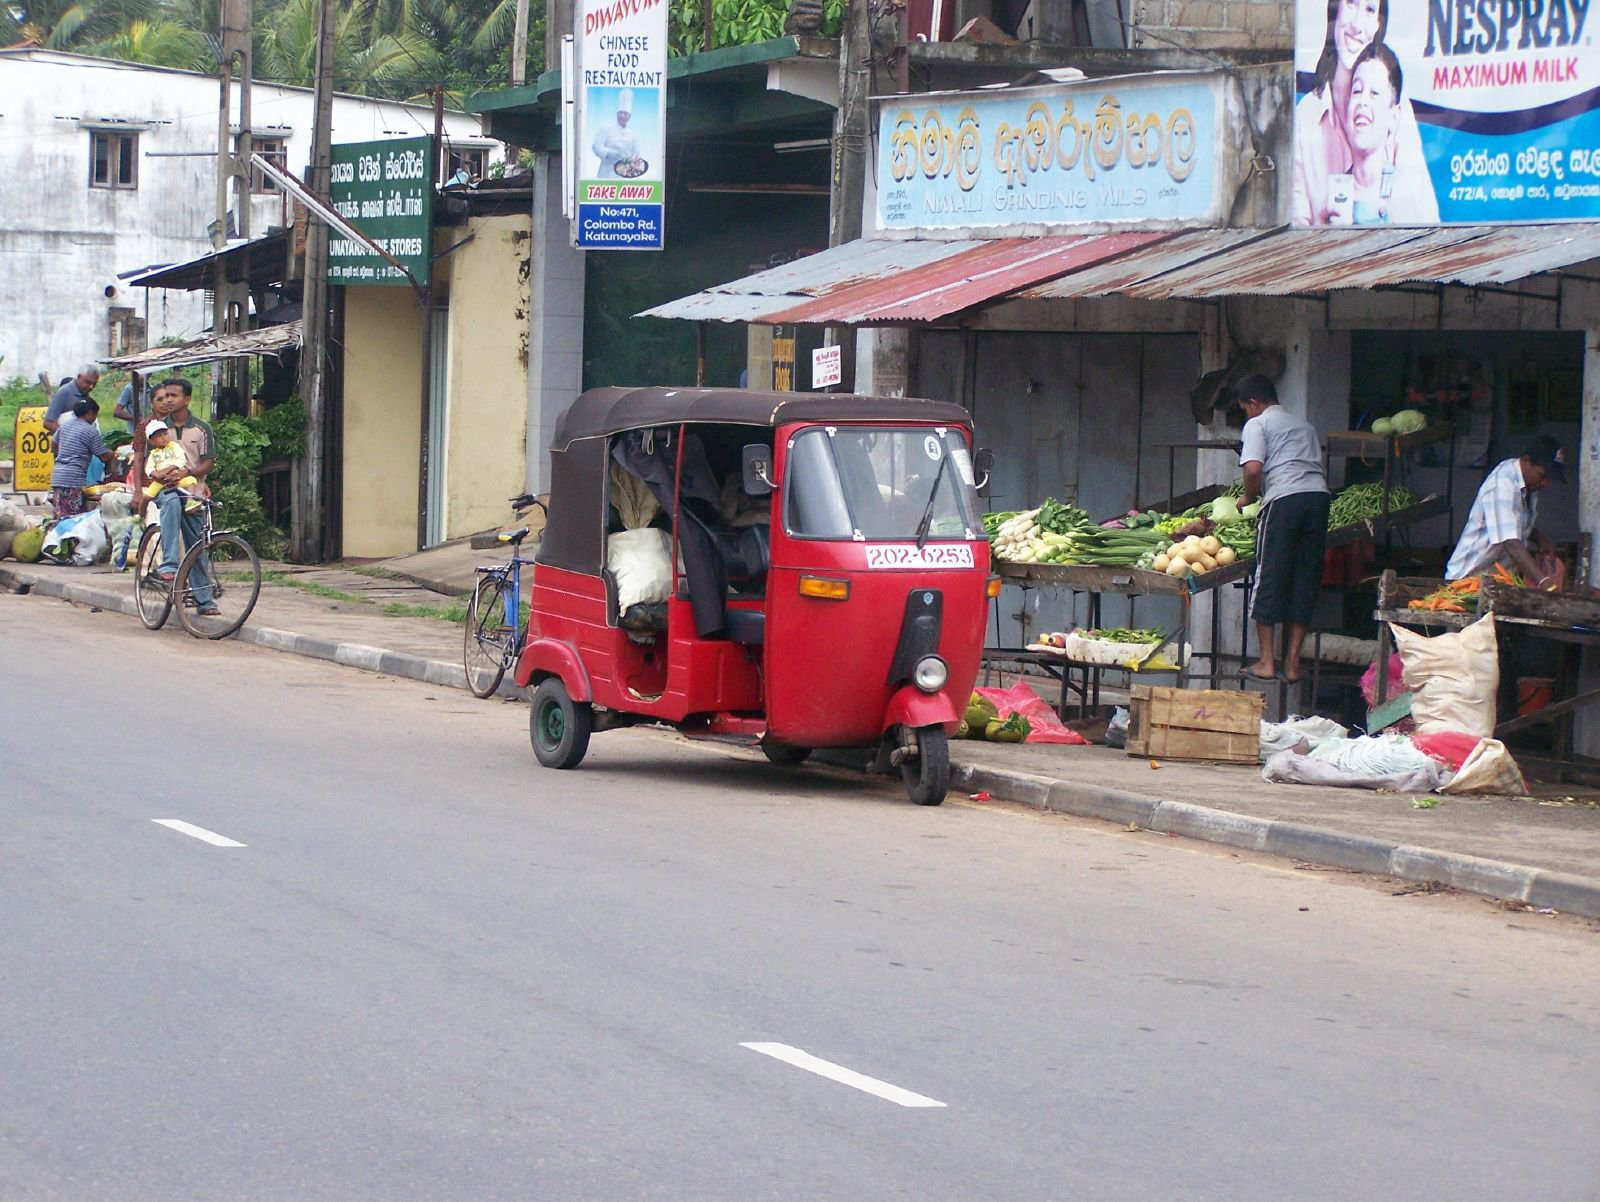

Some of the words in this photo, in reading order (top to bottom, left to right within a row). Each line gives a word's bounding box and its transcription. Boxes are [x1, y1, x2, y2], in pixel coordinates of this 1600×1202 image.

[1423, 0, 1590, 57] NESPRAY
[599, 36, 649, 51] CHINESE
[608, 53, 639, 68] FOOD
[585, 70, 662, 86] RESTAURANT
[1433, 61, 1527, 91] MAXIMUM
[1533, 56, 1578, 83] MILK
[587, 185, 616, 200] TAKE
[619, 185, 654, 200] AWAY
[1449, 186, 1488, 202] 472/A,
[600, 207, 639, 218] No:471,
[584, 219, 635, 230] Colombo
[638, 220, 657, 230] Rd.
[585, 231, 658, 243] Katunayake.
[389, 238, 422, 256] STORES
[869, 548, 972, 565] 202-6253
